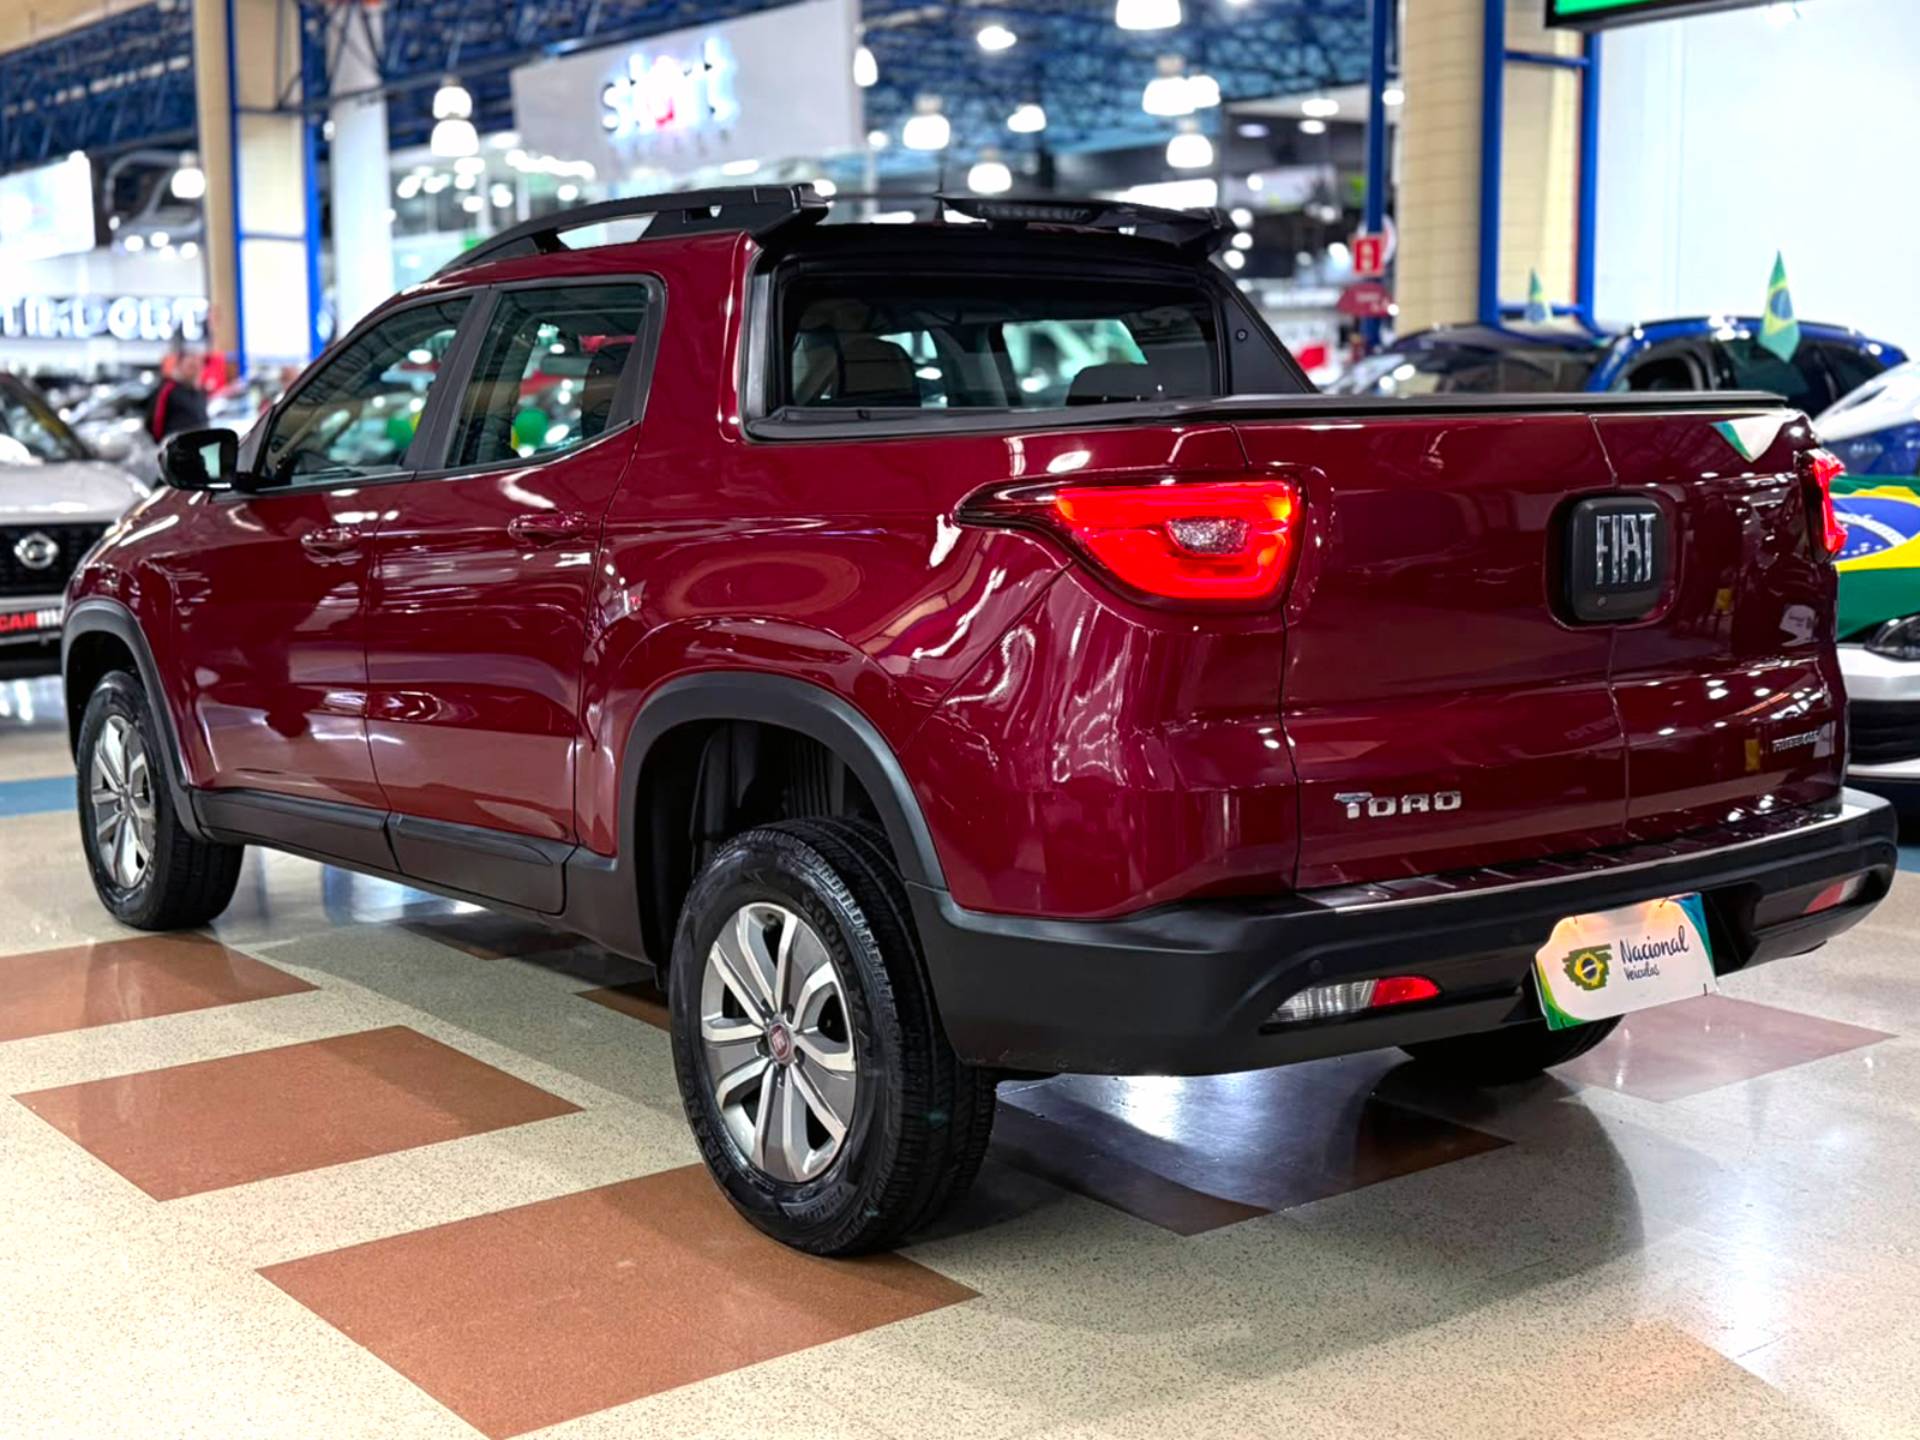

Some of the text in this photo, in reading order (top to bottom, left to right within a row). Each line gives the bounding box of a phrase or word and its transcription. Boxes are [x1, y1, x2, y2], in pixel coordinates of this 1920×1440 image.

[1596, 512, 1657, 586] FIAT
[1333, 790, 1463, 820] TORO
[1620, 924, 1690, 965] Nacional
